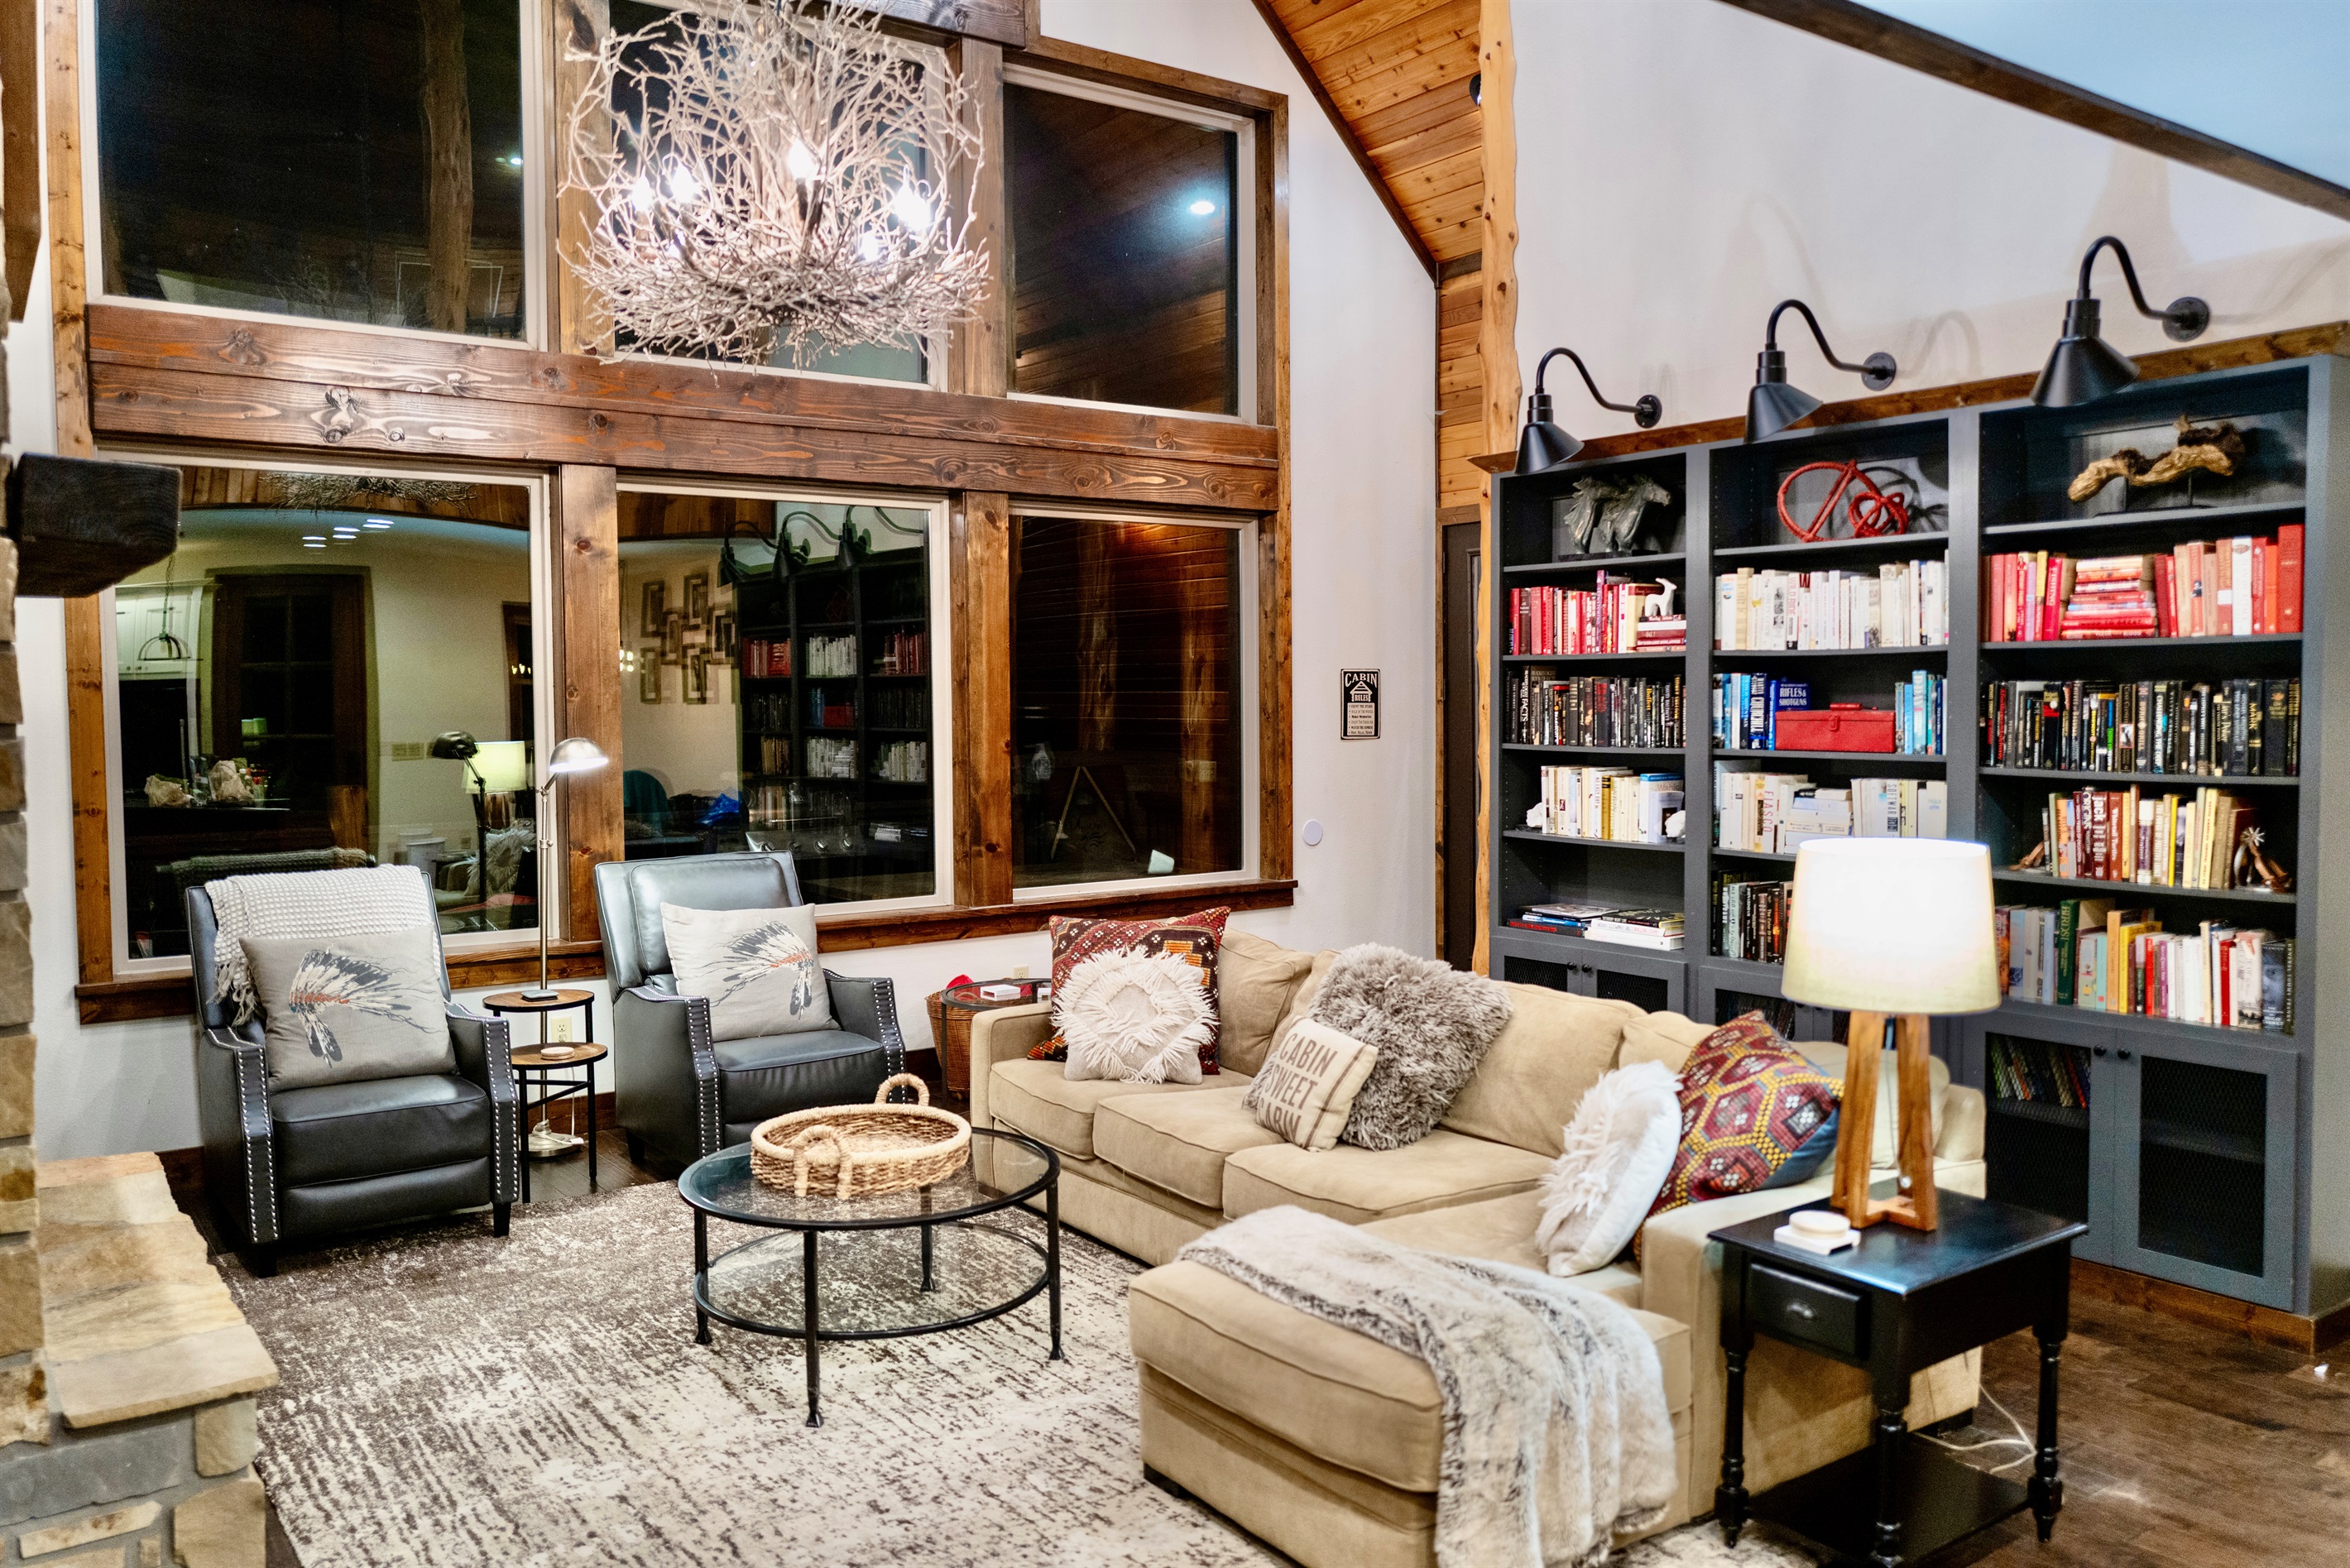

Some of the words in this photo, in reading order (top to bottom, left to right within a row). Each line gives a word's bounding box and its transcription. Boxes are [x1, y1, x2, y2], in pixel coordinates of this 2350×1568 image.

[1787, 577, 1796, 597] WILD
[2049, 567, 2058, 606] FISHING
[1787, 598, 1796, 616] RIDE
[1345, 673, 1378, 688] CABIN
[1354, 693, 1369, 702] RULES
[1778, 698, 1807, 707] SHOTGUNS
[1779, 688, 1802, 698] RIFLES
[2072, 683, 2080, 705] THIEVES
[1750, 697, 1764, 733] CHURCHILL
[2155, 695, 2164, 737] CHALLENGING
[2221, 701, 2232, 720] Liar's
[2248, 703, 2257, 730] MARK
[2137, 730, 2147, 751] DRILL
[2155, 738, 2164, 750] THE
[2221, 722, 2232, 742] Poker
[2155, 751, 2164, 767] DEEP
[1763, 790, 1774, 833] FIASCO
[1887, 784, 1897, 815] SOFTWAR
[2082, 792, 2093, 830] ORIGINS
[2091, 795, 2108, 822] jack
[2111, 808, 2119, 837] Whitetail
[2111, 837, 2119, 861] Tactics
[1279, 1033, 1338, 1078] CABIN
[1265, 1063, 1319, 1110] SWEET
[1258, 1097, 1302, 1142] CABIN
